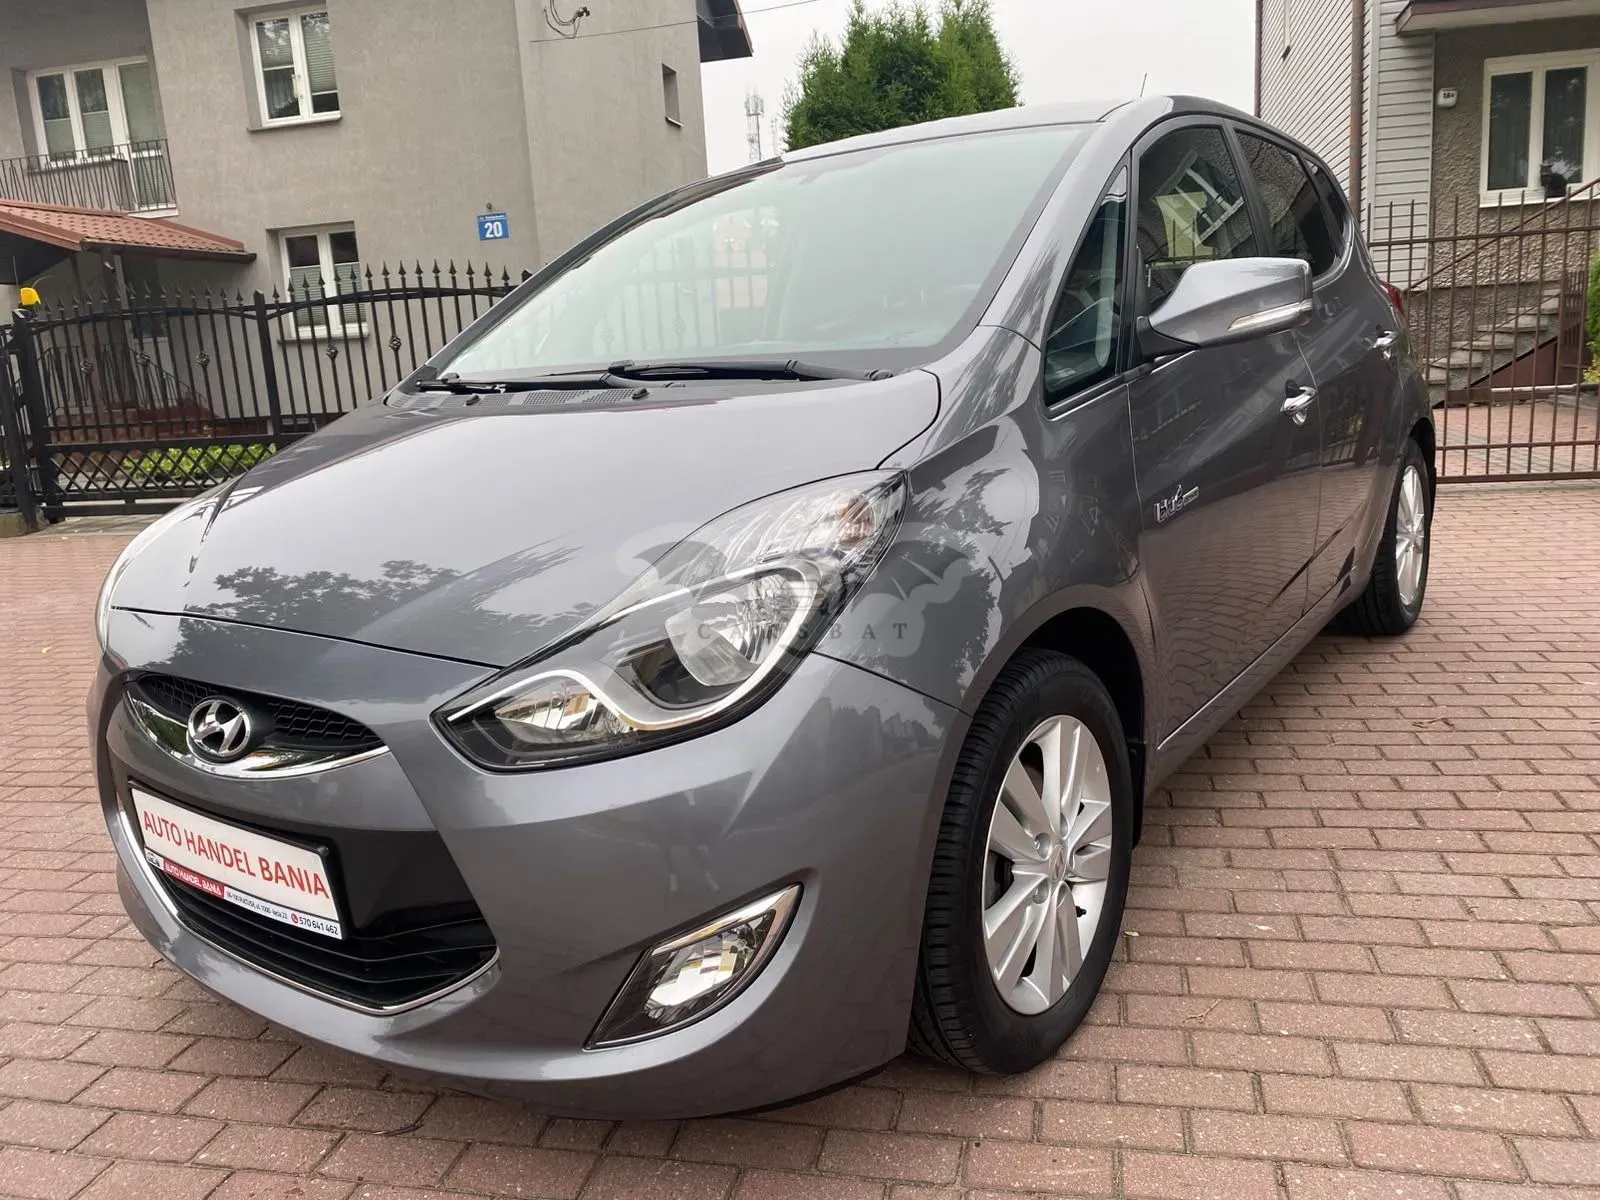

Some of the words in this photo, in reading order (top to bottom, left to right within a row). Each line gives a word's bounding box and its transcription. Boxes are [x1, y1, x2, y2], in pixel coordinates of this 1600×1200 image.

[484, 221, 503, 238] 20
[143, 810, 182, 847] AUTO
[184, 829, 256, 878] HANDEL
[258, 856, 330, 899] BANIA
[299, 916, 312, 928] 570
[312, 920, 325, 931] 641
[325, 924, 339, 935] 462
